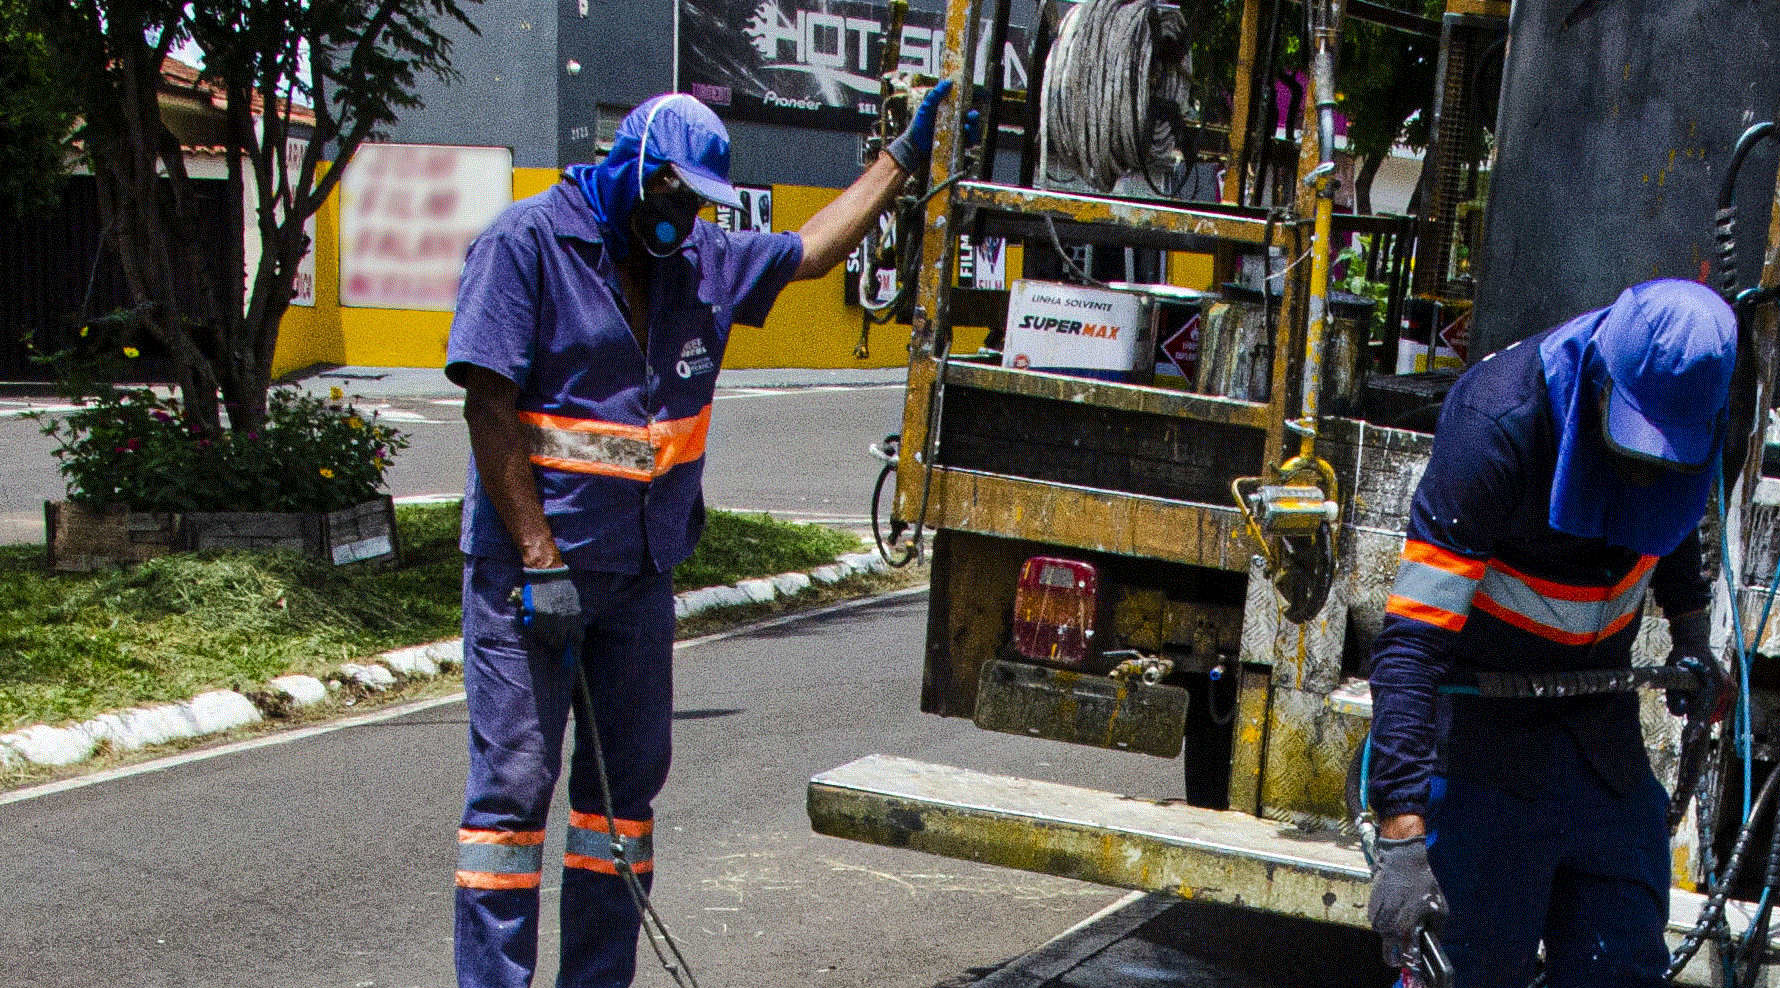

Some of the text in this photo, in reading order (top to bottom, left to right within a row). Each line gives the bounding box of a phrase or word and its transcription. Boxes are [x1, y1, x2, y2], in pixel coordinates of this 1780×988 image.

[744, 3, 880, 71] HOT
[1031, 294, 1113, 312] LINHA SOLVENTE
[1018, 315, 1120, 341] SUPERMAX
